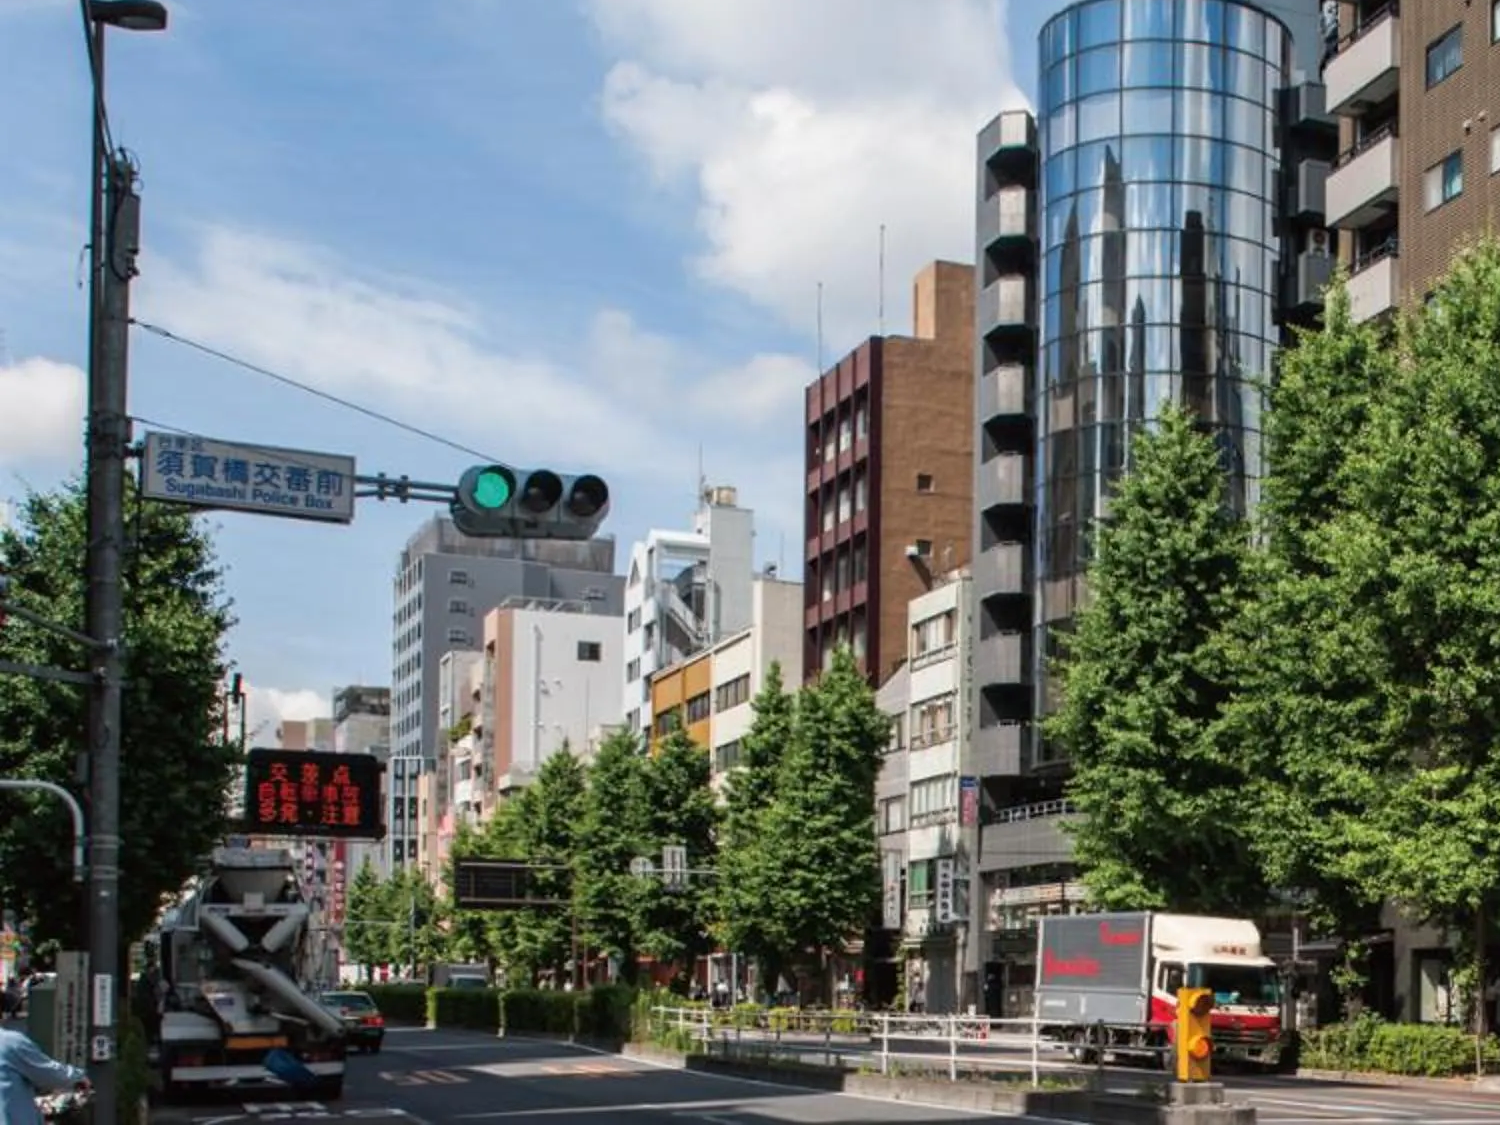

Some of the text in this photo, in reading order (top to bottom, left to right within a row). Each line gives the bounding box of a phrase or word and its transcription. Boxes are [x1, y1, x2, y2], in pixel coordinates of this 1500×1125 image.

[156, 450, 343, 496] 須賀橋交番前
[165, 477, 334, 510] Sugabashi Police Box
